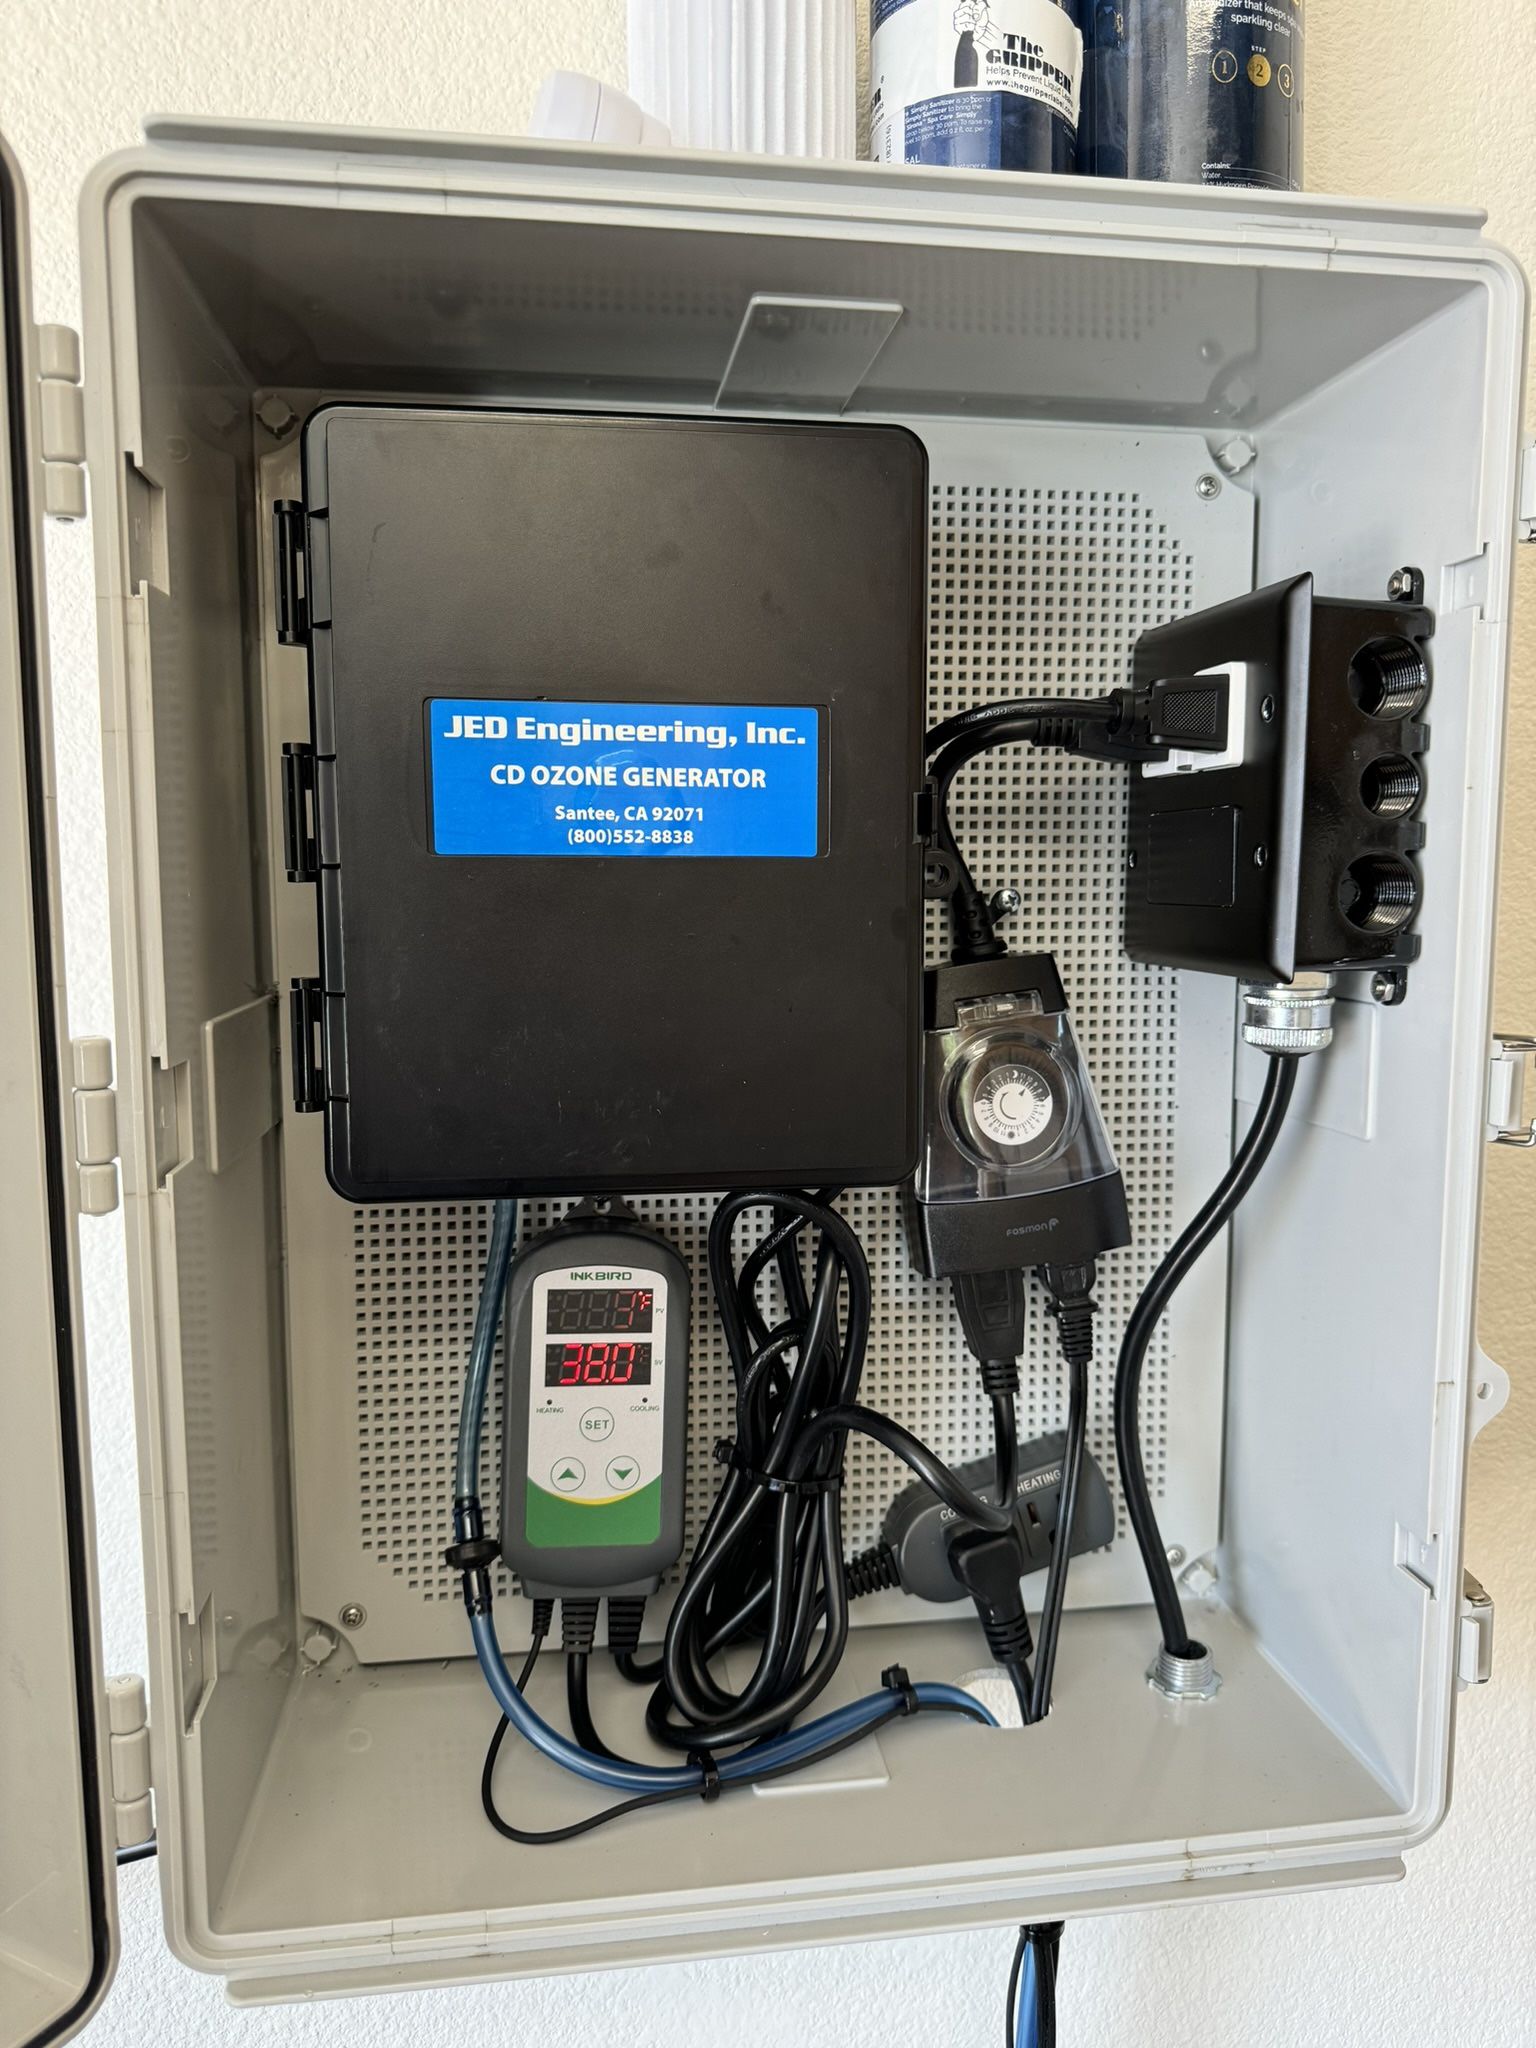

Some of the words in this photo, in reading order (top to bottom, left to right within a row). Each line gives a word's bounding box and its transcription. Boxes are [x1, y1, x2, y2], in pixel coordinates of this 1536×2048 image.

[1244, 0, 1263, 11] that
[1264, 3, 1286, 20] keeps
[1230, 13, 1274, 31] sparkling
[1273, 22, 1291, 37] clear
[1003, 33, 1044, 58] The
[1250, 45, 1267, 53] STEP
[986, 49, 1071, 95] GRIPPER
[986, 66, 1011, 77] Helps
[1013, 68, 1043, 86] Prevent
[1043, 78, 1061, 96] Liquid
[1221, 60, 1228, 74] 1
[1256, 63, 1264, 78] 2
[1283, 73, 1290, 88] 3
[922, 107, 948, 117] Sanitizer
[929, 99, 956, 108] Sanitizer
[444, 715, 508, 739] JED
[516, 717, 738, 749] Engineering,
[746, 722, 806, 745] Inc.
[490, 764, 525, 786] CD
[531, 764, 618, 787] OZONE
[622, 766, 767, 788] GENERATOR
[554, 805, 621, 823] Santee,
[624, 806, 648, 822] CA
[652, 806, 704, 823] 92071
[567, 829, 694, 845] (800)552-8838
[570, 1272, 632, 1281] INKBIRD
[559, 1343, 636, 1385] 38.0
[585, 1420, 610, 1430] SET
[1017, 1469, 1061, 1494] HEATING
